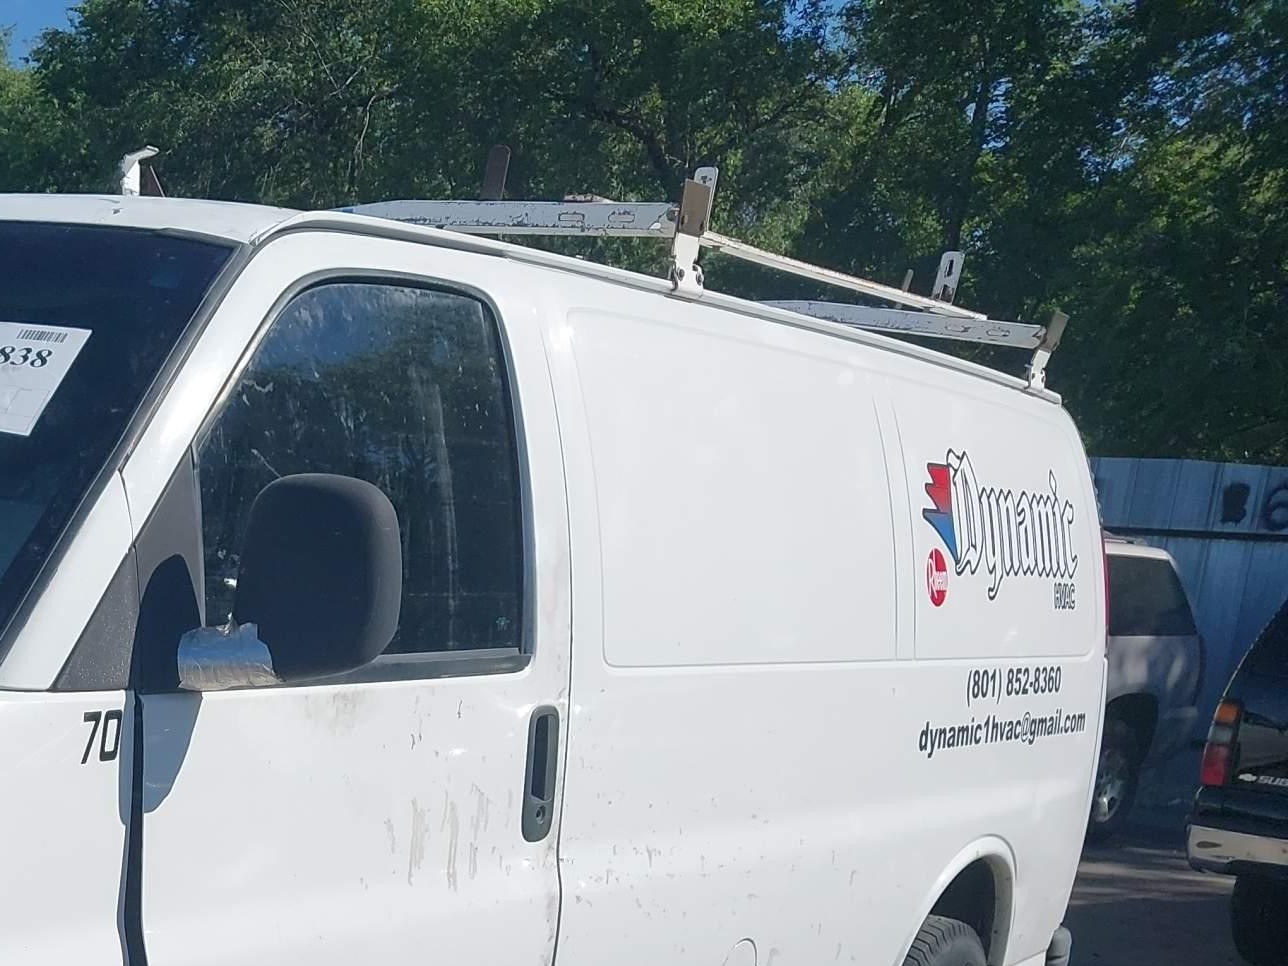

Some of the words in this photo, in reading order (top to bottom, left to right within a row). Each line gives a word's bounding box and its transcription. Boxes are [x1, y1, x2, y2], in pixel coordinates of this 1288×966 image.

[946, 448, 1079, 601] Dynamic
[967, 668, 1002, 706] (801)
[1006, 665, 1061, 696] 852-8360
[81, 709, 122, 764] 70
[918, 709, 1086, 758] dynamic1hvac@gmail.com
